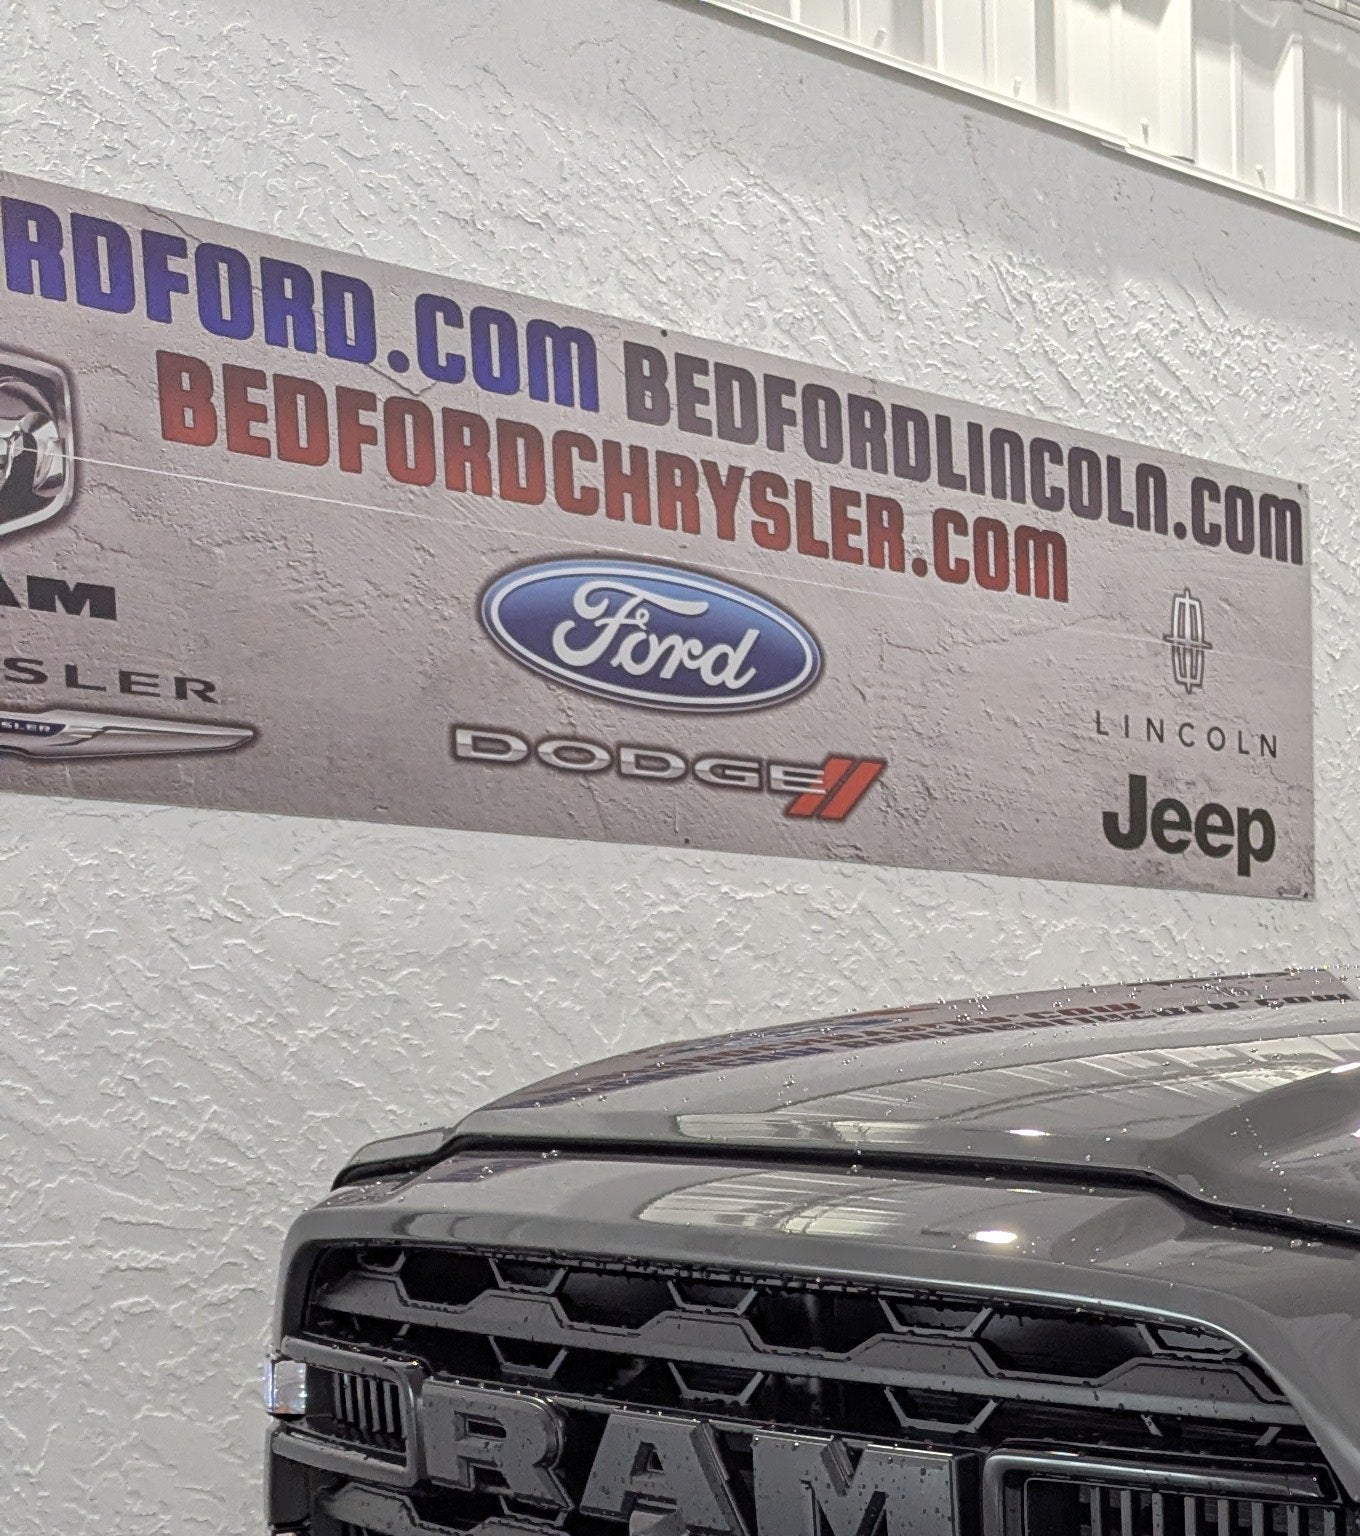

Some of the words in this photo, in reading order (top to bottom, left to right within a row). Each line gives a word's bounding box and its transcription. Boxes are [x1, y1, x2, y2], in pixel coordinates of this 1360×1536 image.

[1, 195, 600, 413] RDFORD.COM
[623, 340, 1303, 566] BEDFORDLINCOLN.COM
[156, 349, 1069, 603] BEDFORDCHRYSLER.COM
[3, 657, 219, 704] SLER
[552, 580, 760, 690] Ford
[454, 727, 826, 795] DODGE
[1095, 710, 1279, 758] LINCOLN
[1103, 774, 1276, 877] Jeep
